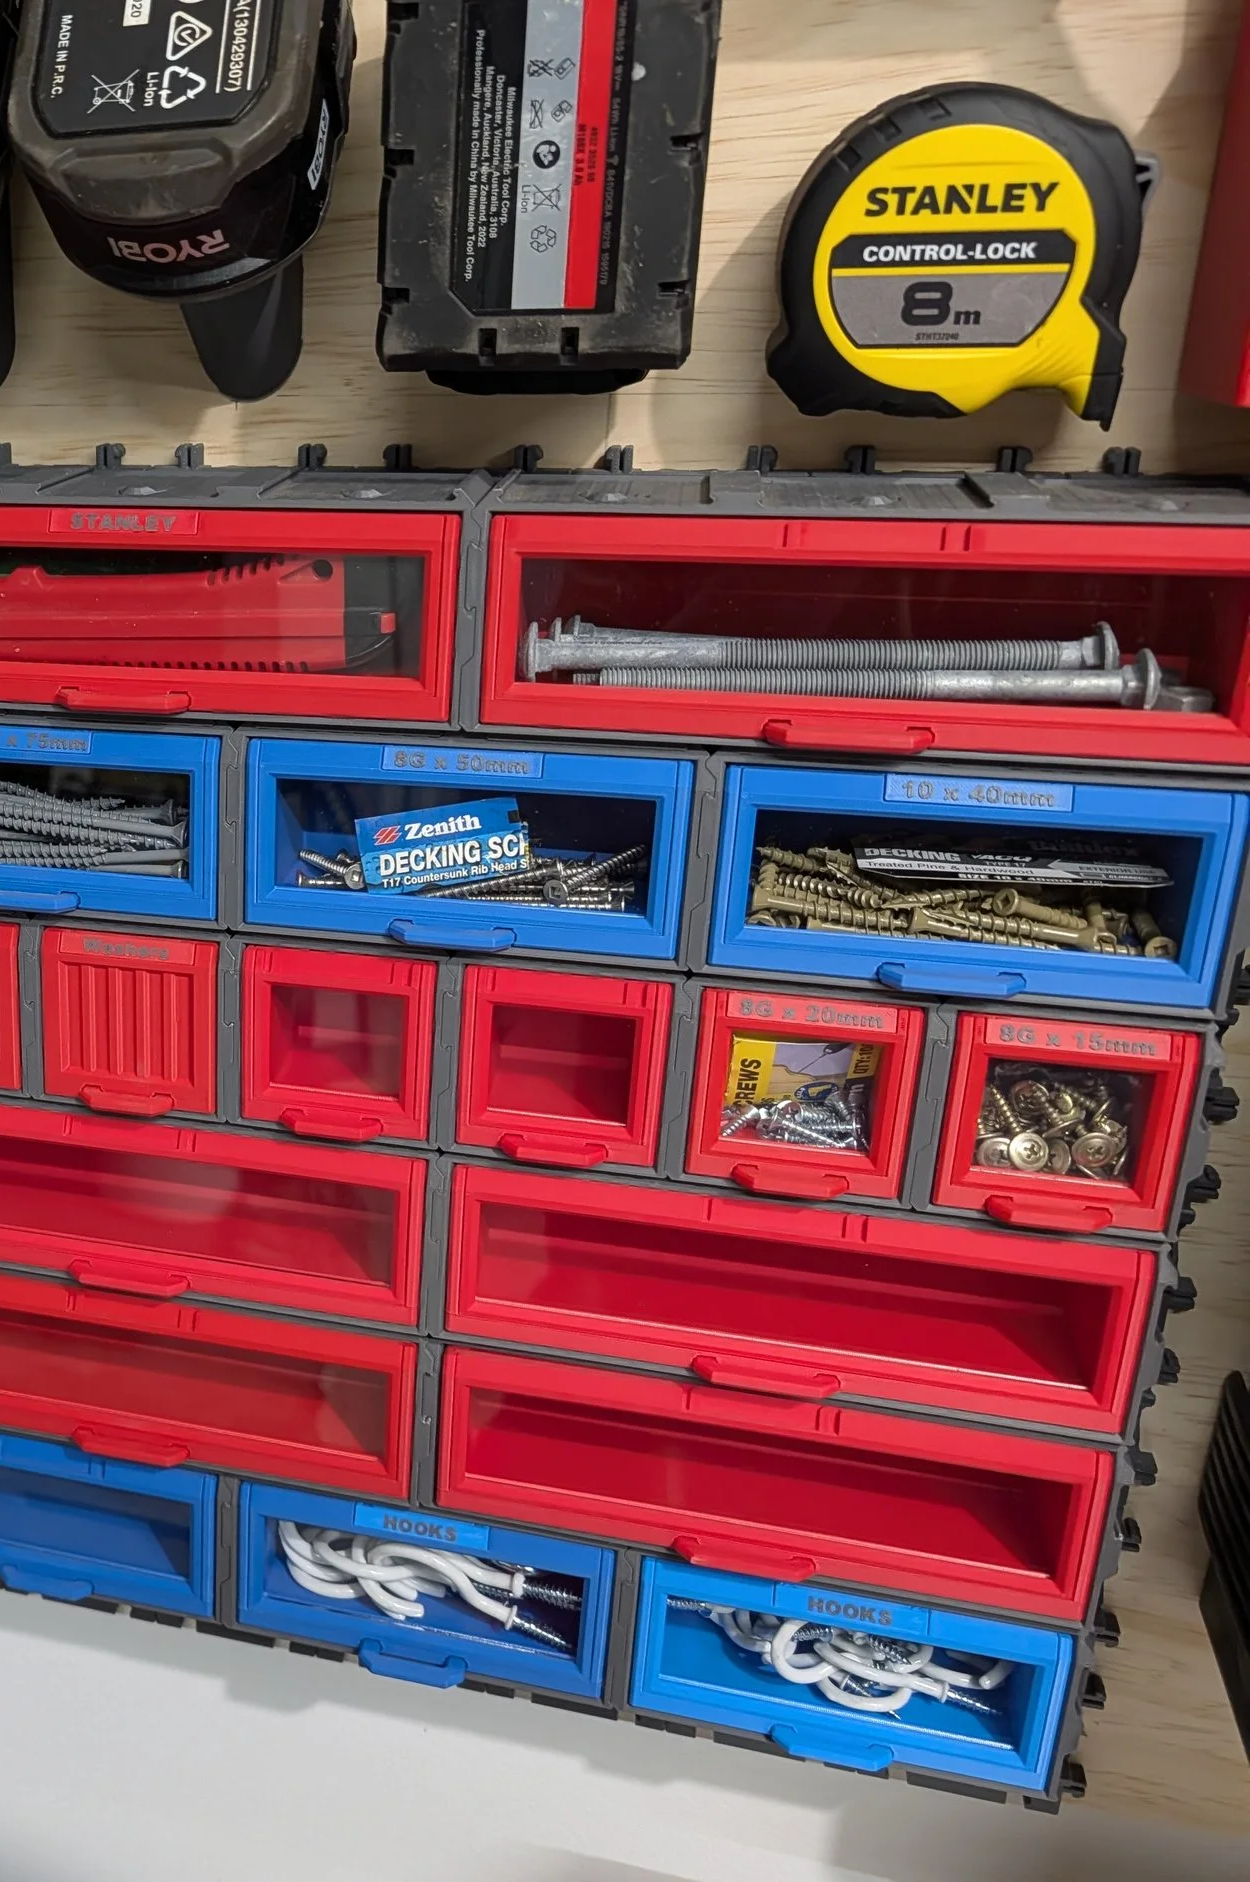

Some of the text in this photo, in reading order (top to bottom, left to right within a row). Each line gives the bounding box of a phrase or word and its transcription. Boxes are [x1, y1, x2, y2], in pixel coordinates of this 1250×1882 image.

[50, 14, 74, 98] MADE IN P.R.C.
[483, 66, 495, 111] Mangere,
[481, 112, 492, 160] Auckland,
[464, 29, 486, 282] Professionally made in China by Milwaukee Tool Corp.
[489, 74, 506, 239] Doncaster, Victoria, Australia, 3108
[499, 86, 517, 226] Milwaukee Electric Tool Corp.
[478, 184, 489, 224] Zealand,
[521, 185, 531, 213] Li-Ion
[864, 181, 1059, 217] STANLEY
[107, 229, 230, 264] RYOBI
[477, 226, 486, 248] 2022
[862, 241, 1038, 263] CONTROL-LOCK
[70, 512, 176, 532] STANLEY
[6, 735, 17, 747] x
[25, 732, 88, 751] 75mm
[394, 750, 529, 775] 8G x 50mm
[902, 780, 1055, 807] 10 x 40mm
[404, 814, 482, 840] Zenith
[380, 841, 481, 876] DECKING
[864, 848, 961, 862] DECKING
[917, 862, 946, 870] Pine
[964, 865, 1034, 875] Hardwood
[382, 876, 401, 888] T17
[404, 869, 468, 886] Countersunk
[471, 865, 488, 876] Rib
[491, 860, 517, 872] Head
[82, 936, 169, 960] Washers
[739, 999, 885, 1029] 8G x 20mm
[999, 1023, 1156, 1056] 8G x 15mm
[383, 1513, 456, 1542] HOOKS
[807, 1595, 893, 1626] HOOKS
